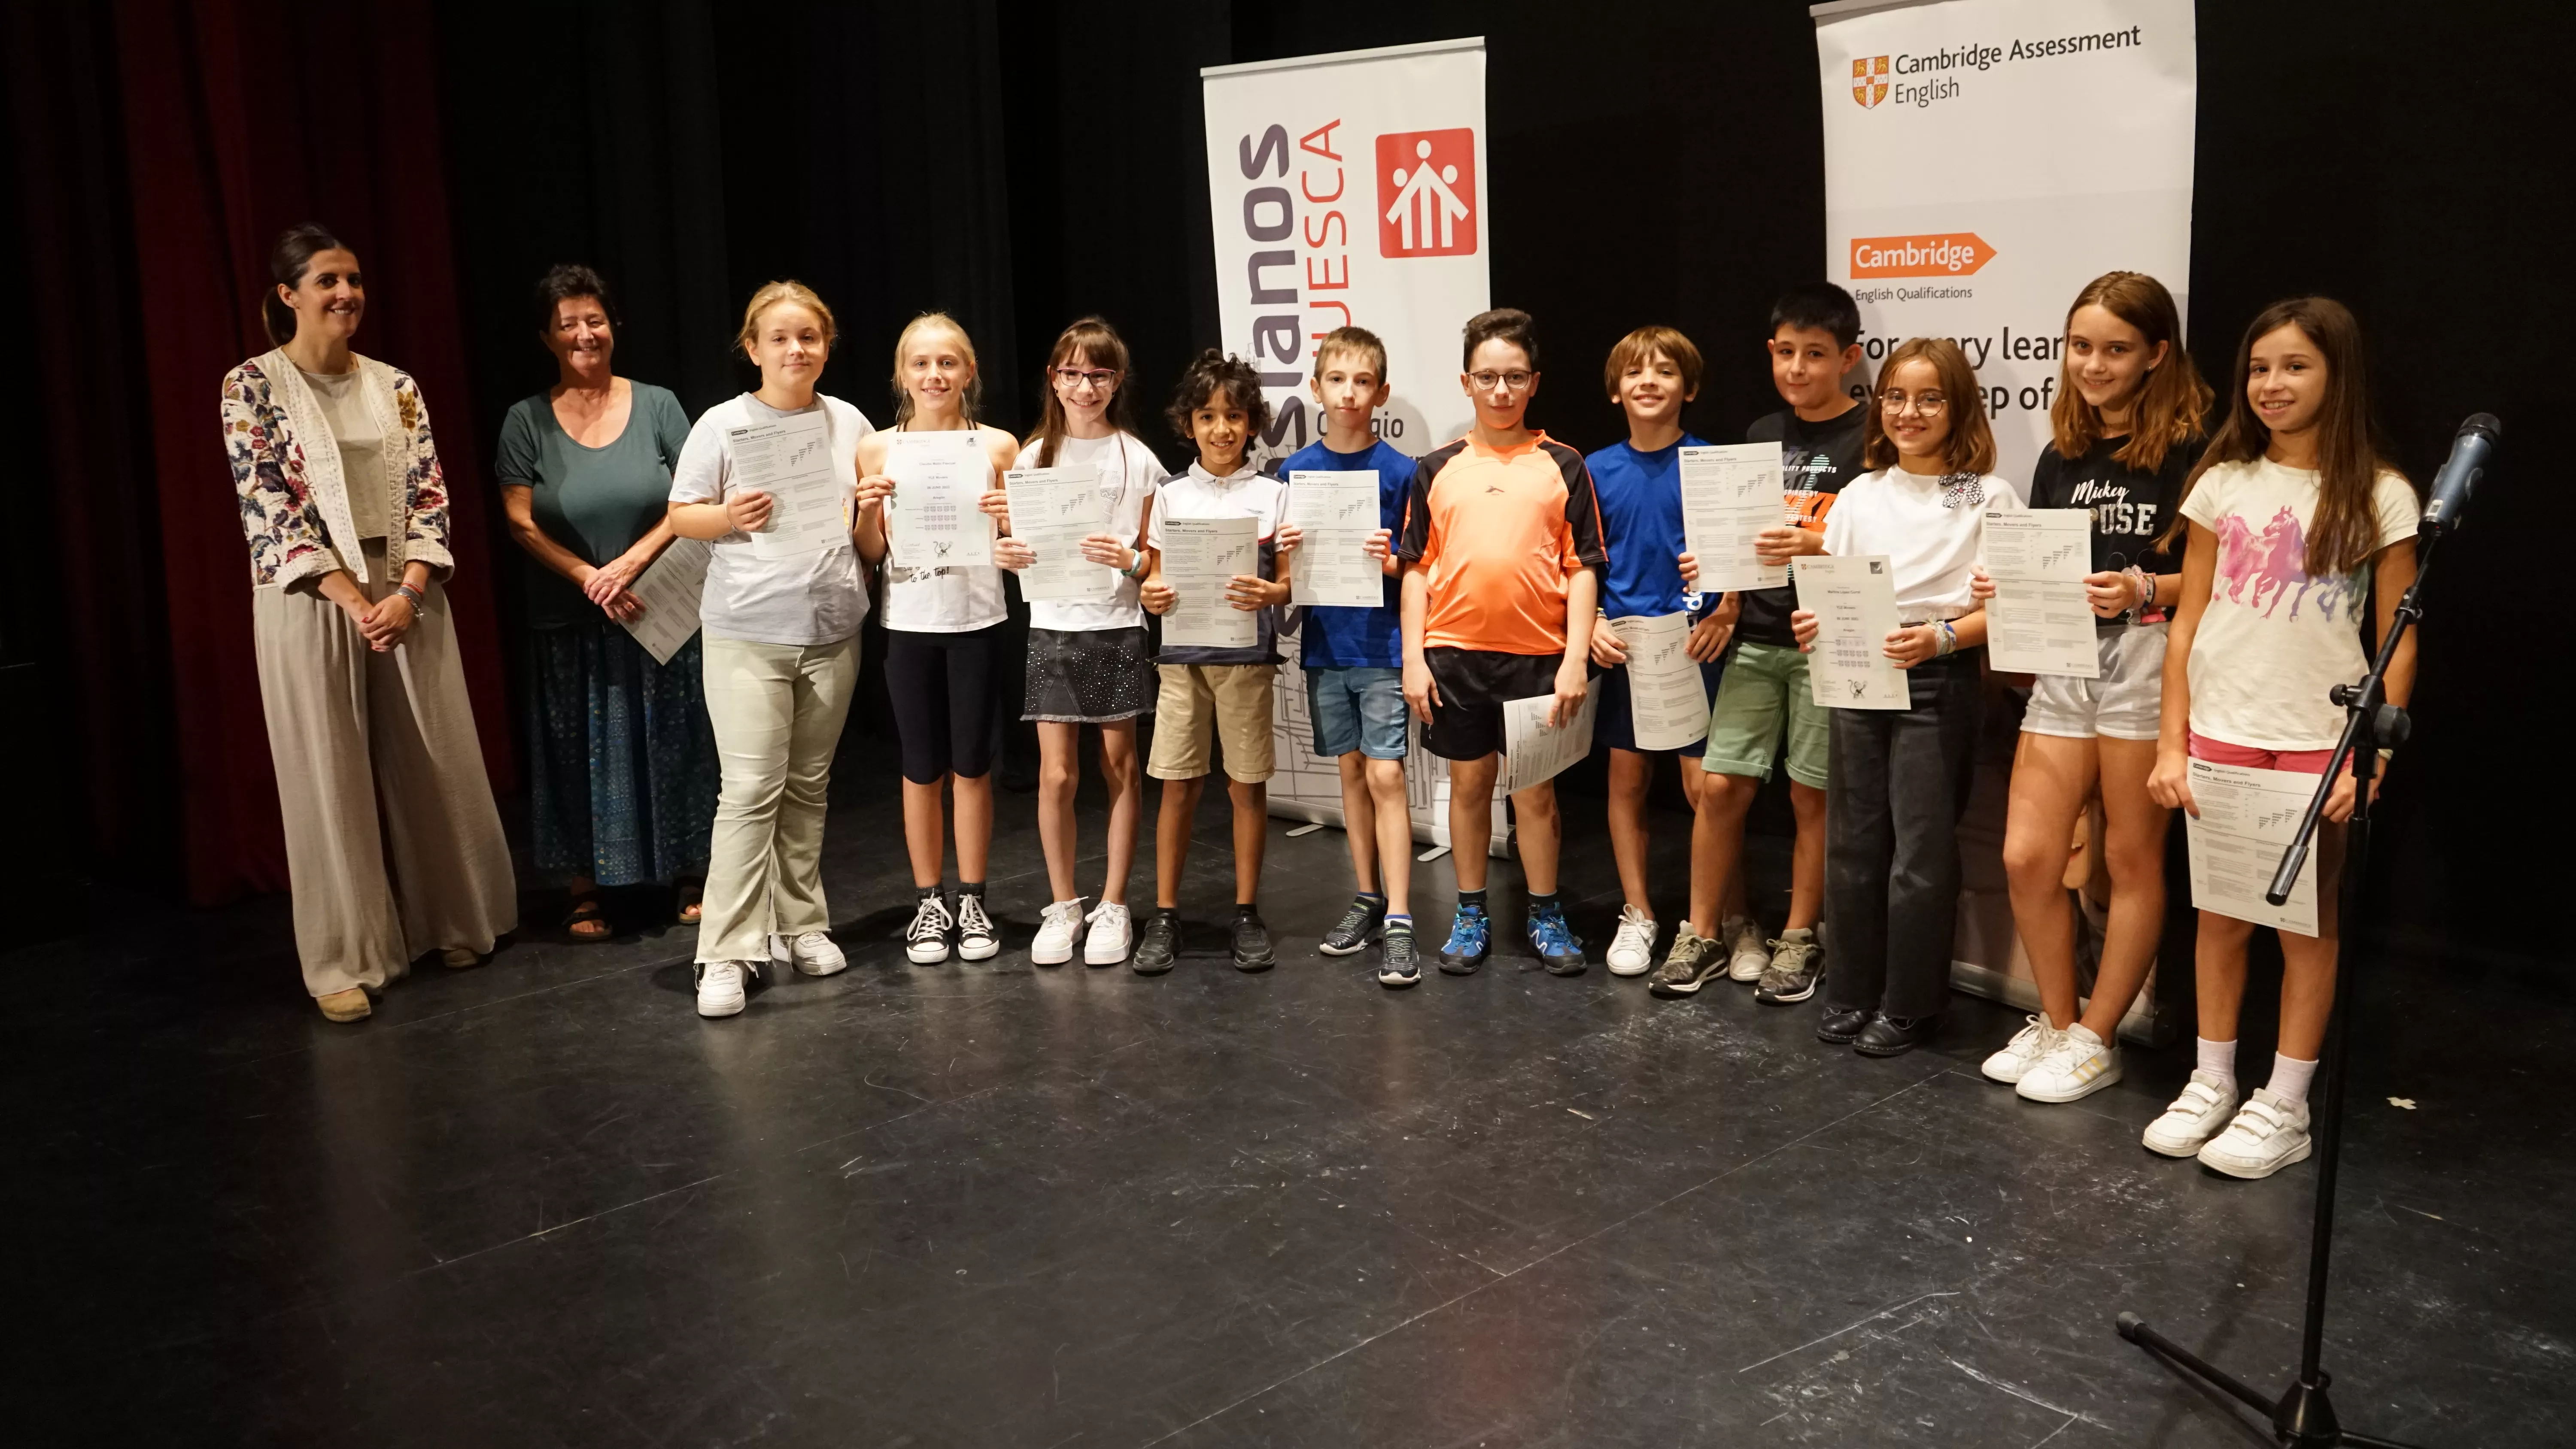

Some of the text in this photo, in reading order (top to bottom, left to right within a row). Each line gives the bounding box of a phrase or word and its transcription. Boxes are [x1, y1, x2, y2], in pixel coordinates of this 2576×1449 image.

[1896, 25, 2142, 74] Cambridge Assessment
[1895, 77, 1960, 108] English
[1856, 239, 1975, 272] Cambridge
[1239, 124, 1306, 475] sianos
[1856, 286, 1973, 303] English Qualifications
[2003, 327, 2063, 360] lear
[2019, 377, 2054, 410] of
[2071, 479, 2130, 508] Mickey
[2090, 503, 2157, 536] USE
[909, 573, 917, 582] to
[933, 567, 949, 579] top!
